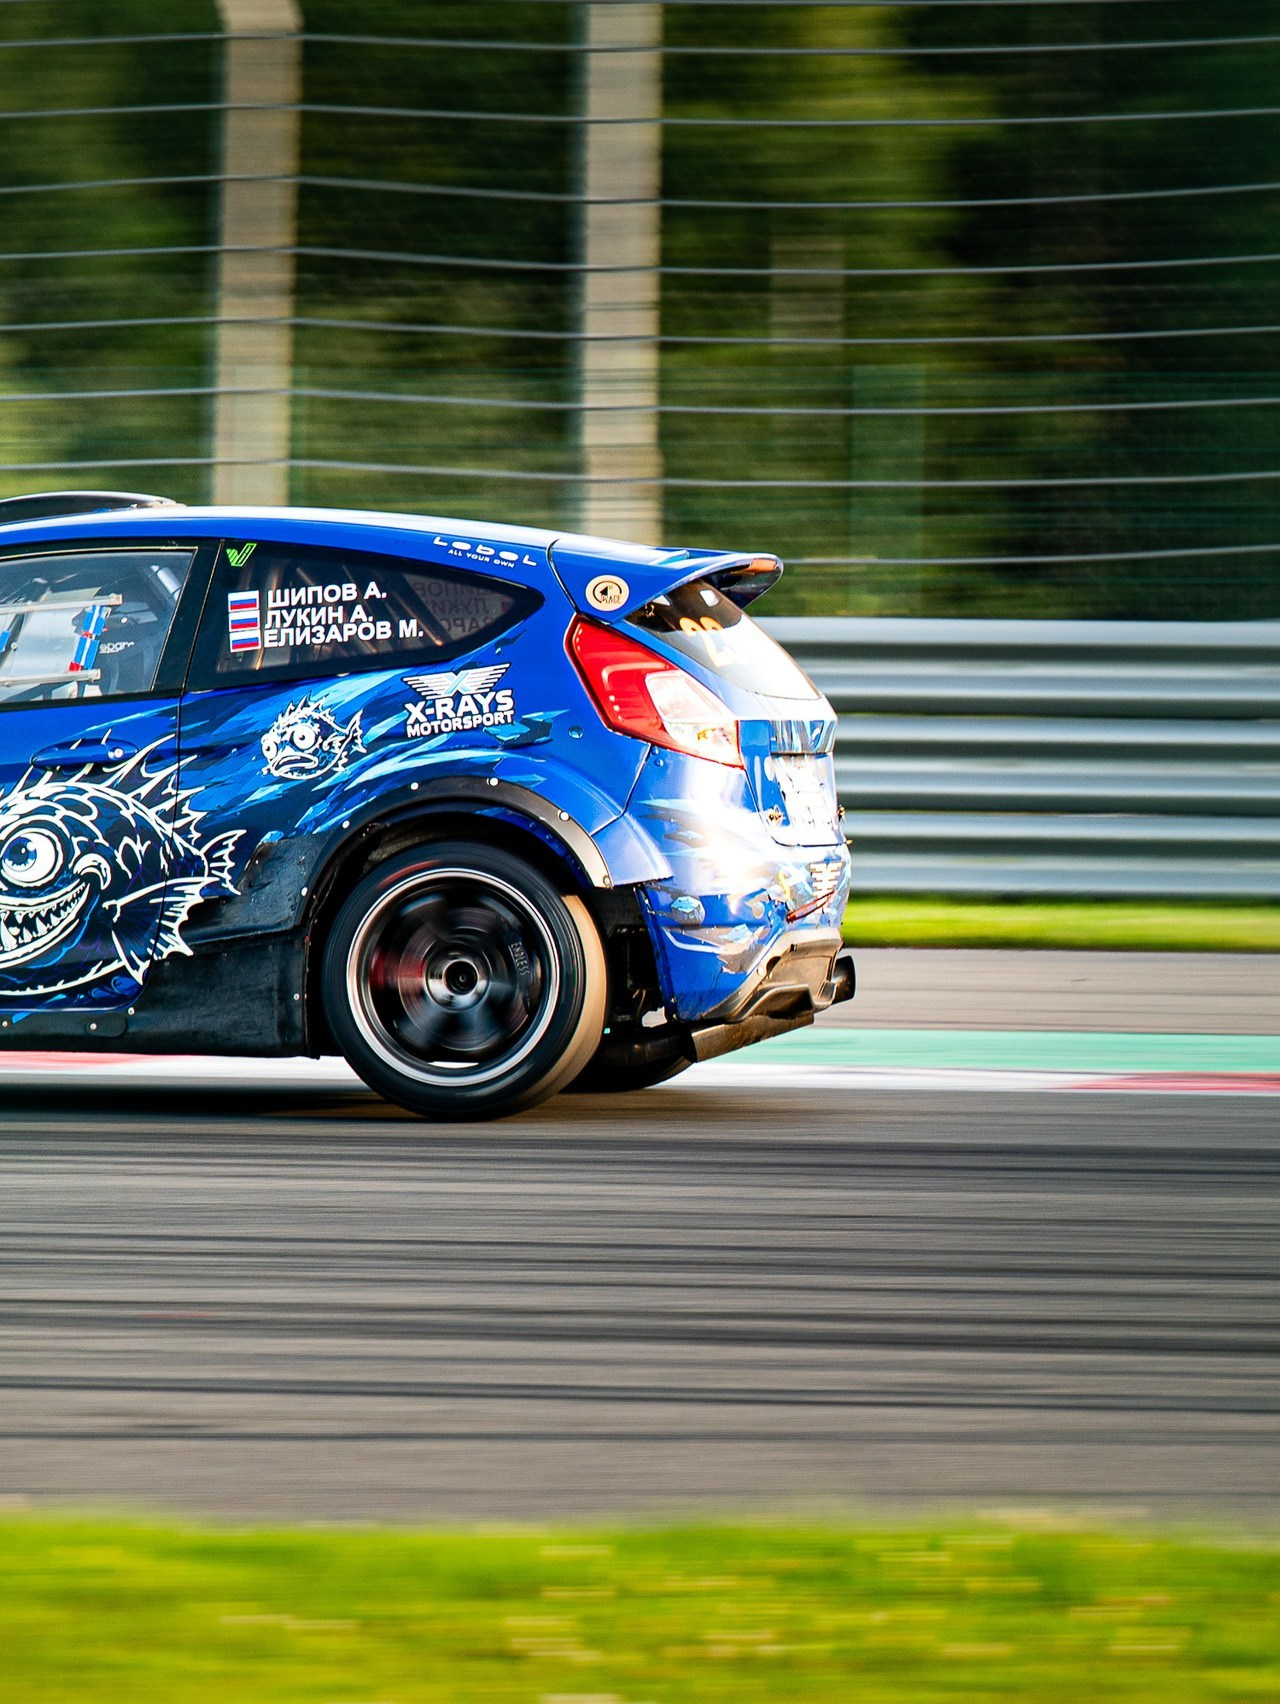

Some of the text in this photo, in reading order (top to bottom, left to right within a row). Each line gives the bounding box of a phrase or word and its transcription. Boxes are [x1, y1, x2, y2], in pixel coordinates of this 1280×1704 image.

[448, 549, 515, 568] ALL YOUR OWN
[268, 582, 387, 608] ШИПОВ А.
[265, 605, 373, 628] ЛУКИН А.
[264, 619, 424, 648] ЕЛИЗАРОВ М.
[405, 690, 514, 724] X-RAYS
[407, 710, 515, 738] MOTORSPORT
